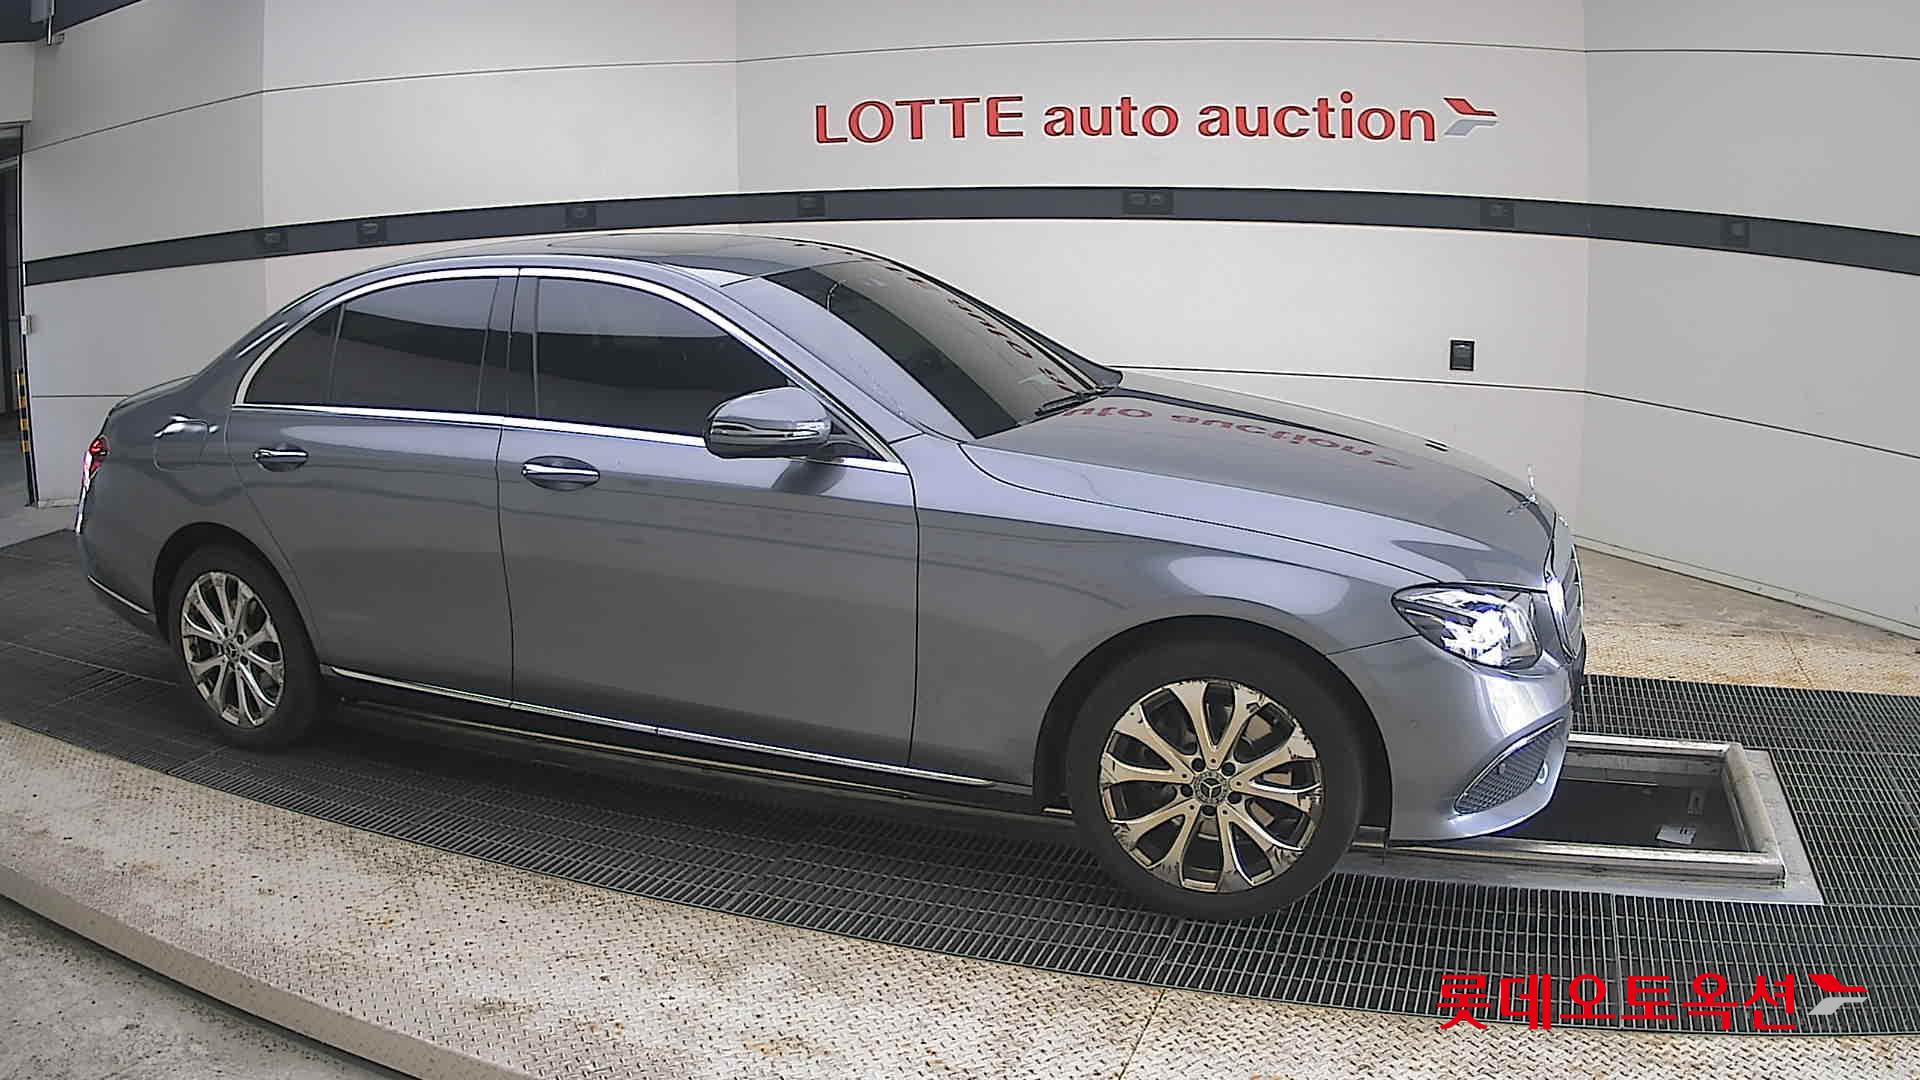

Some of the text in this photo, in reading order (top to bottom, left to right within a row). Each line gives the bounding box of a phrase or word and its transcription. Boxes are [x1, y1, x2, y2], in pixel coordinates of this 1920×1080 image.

[815, 90, 1437, 143] LOTTE auto auction
